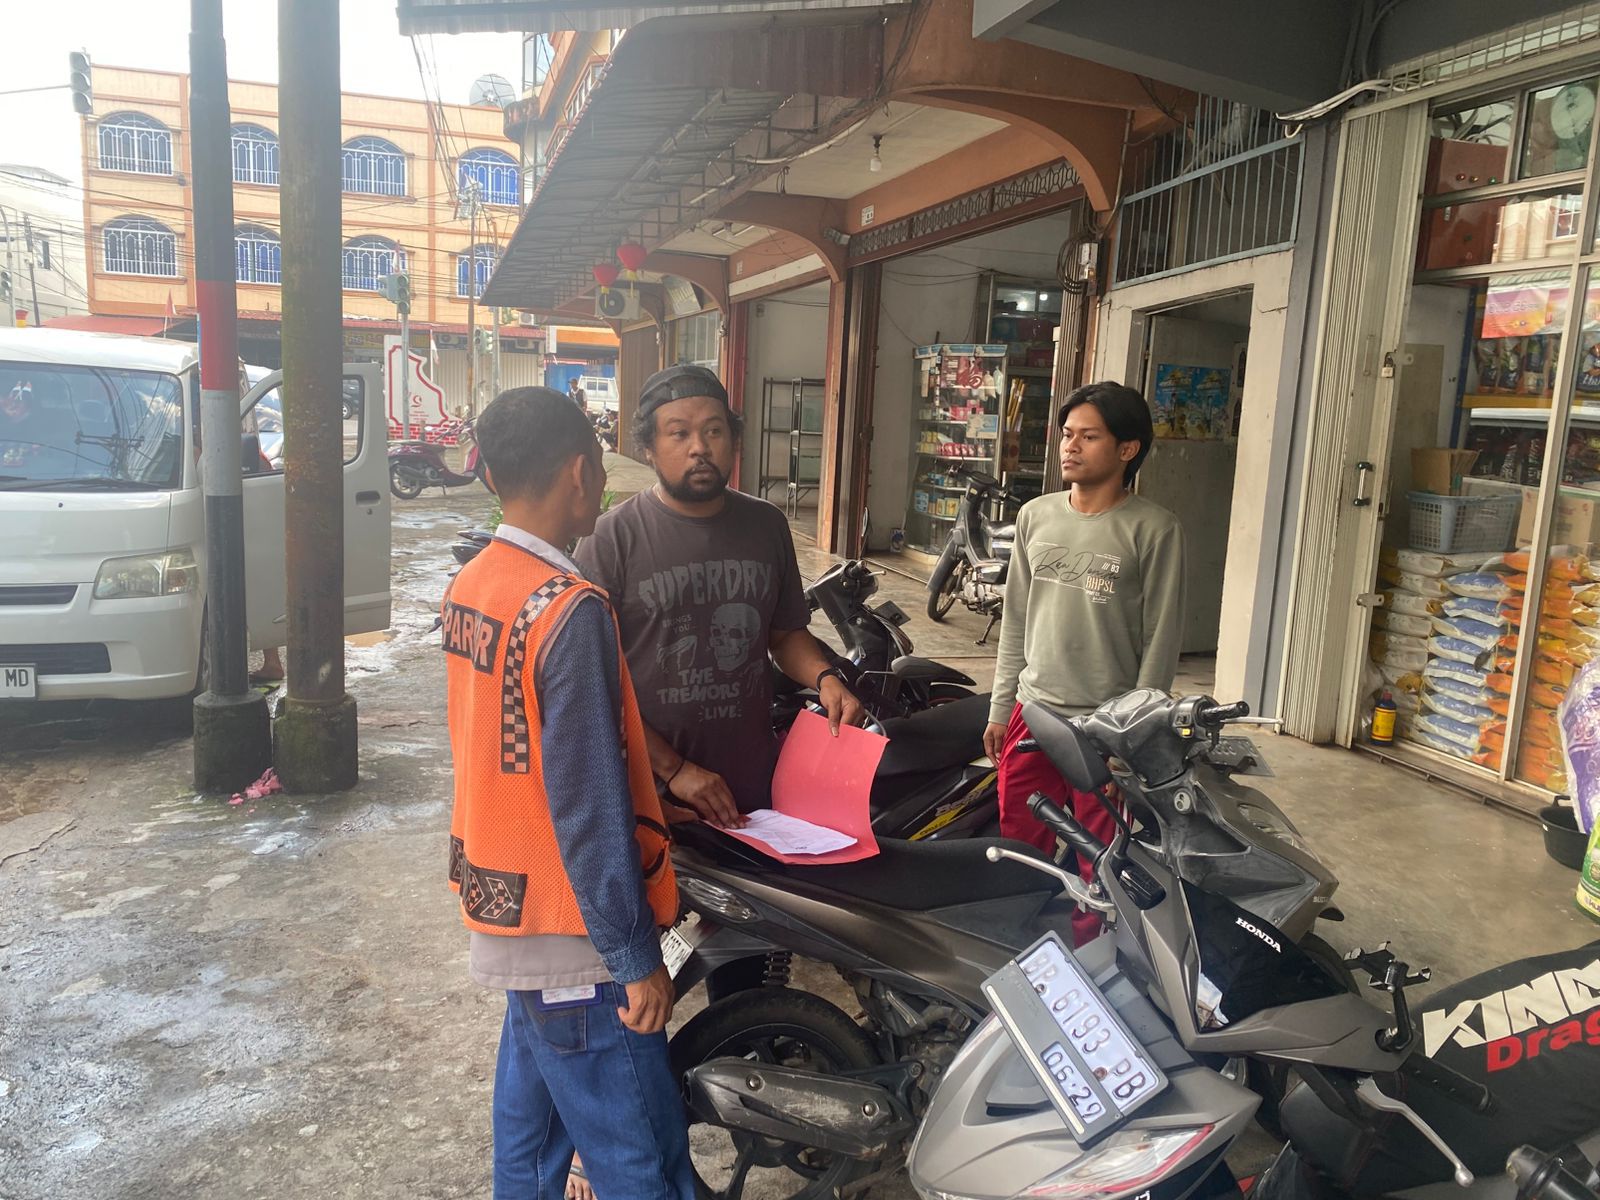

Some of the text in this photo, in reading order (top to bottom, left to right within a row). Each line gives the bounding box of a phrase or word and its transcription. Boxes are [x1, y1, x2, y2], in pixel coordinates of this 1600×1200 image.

[1110, 563, 1120, 574] 83
[639, 559, 773, 614] SUPERDRY
[5, 668, 28, 687] MD
[678, 667, 714, 685] THE
[656, 682, 741, 705] TREMORS
[704, 705, 737, 720] LIVE
[1235, 917, 1281, 953] HONDA
[1052, 988, 1111, 1054] 6193
[1111, 1057, 1147, 1100] PB
